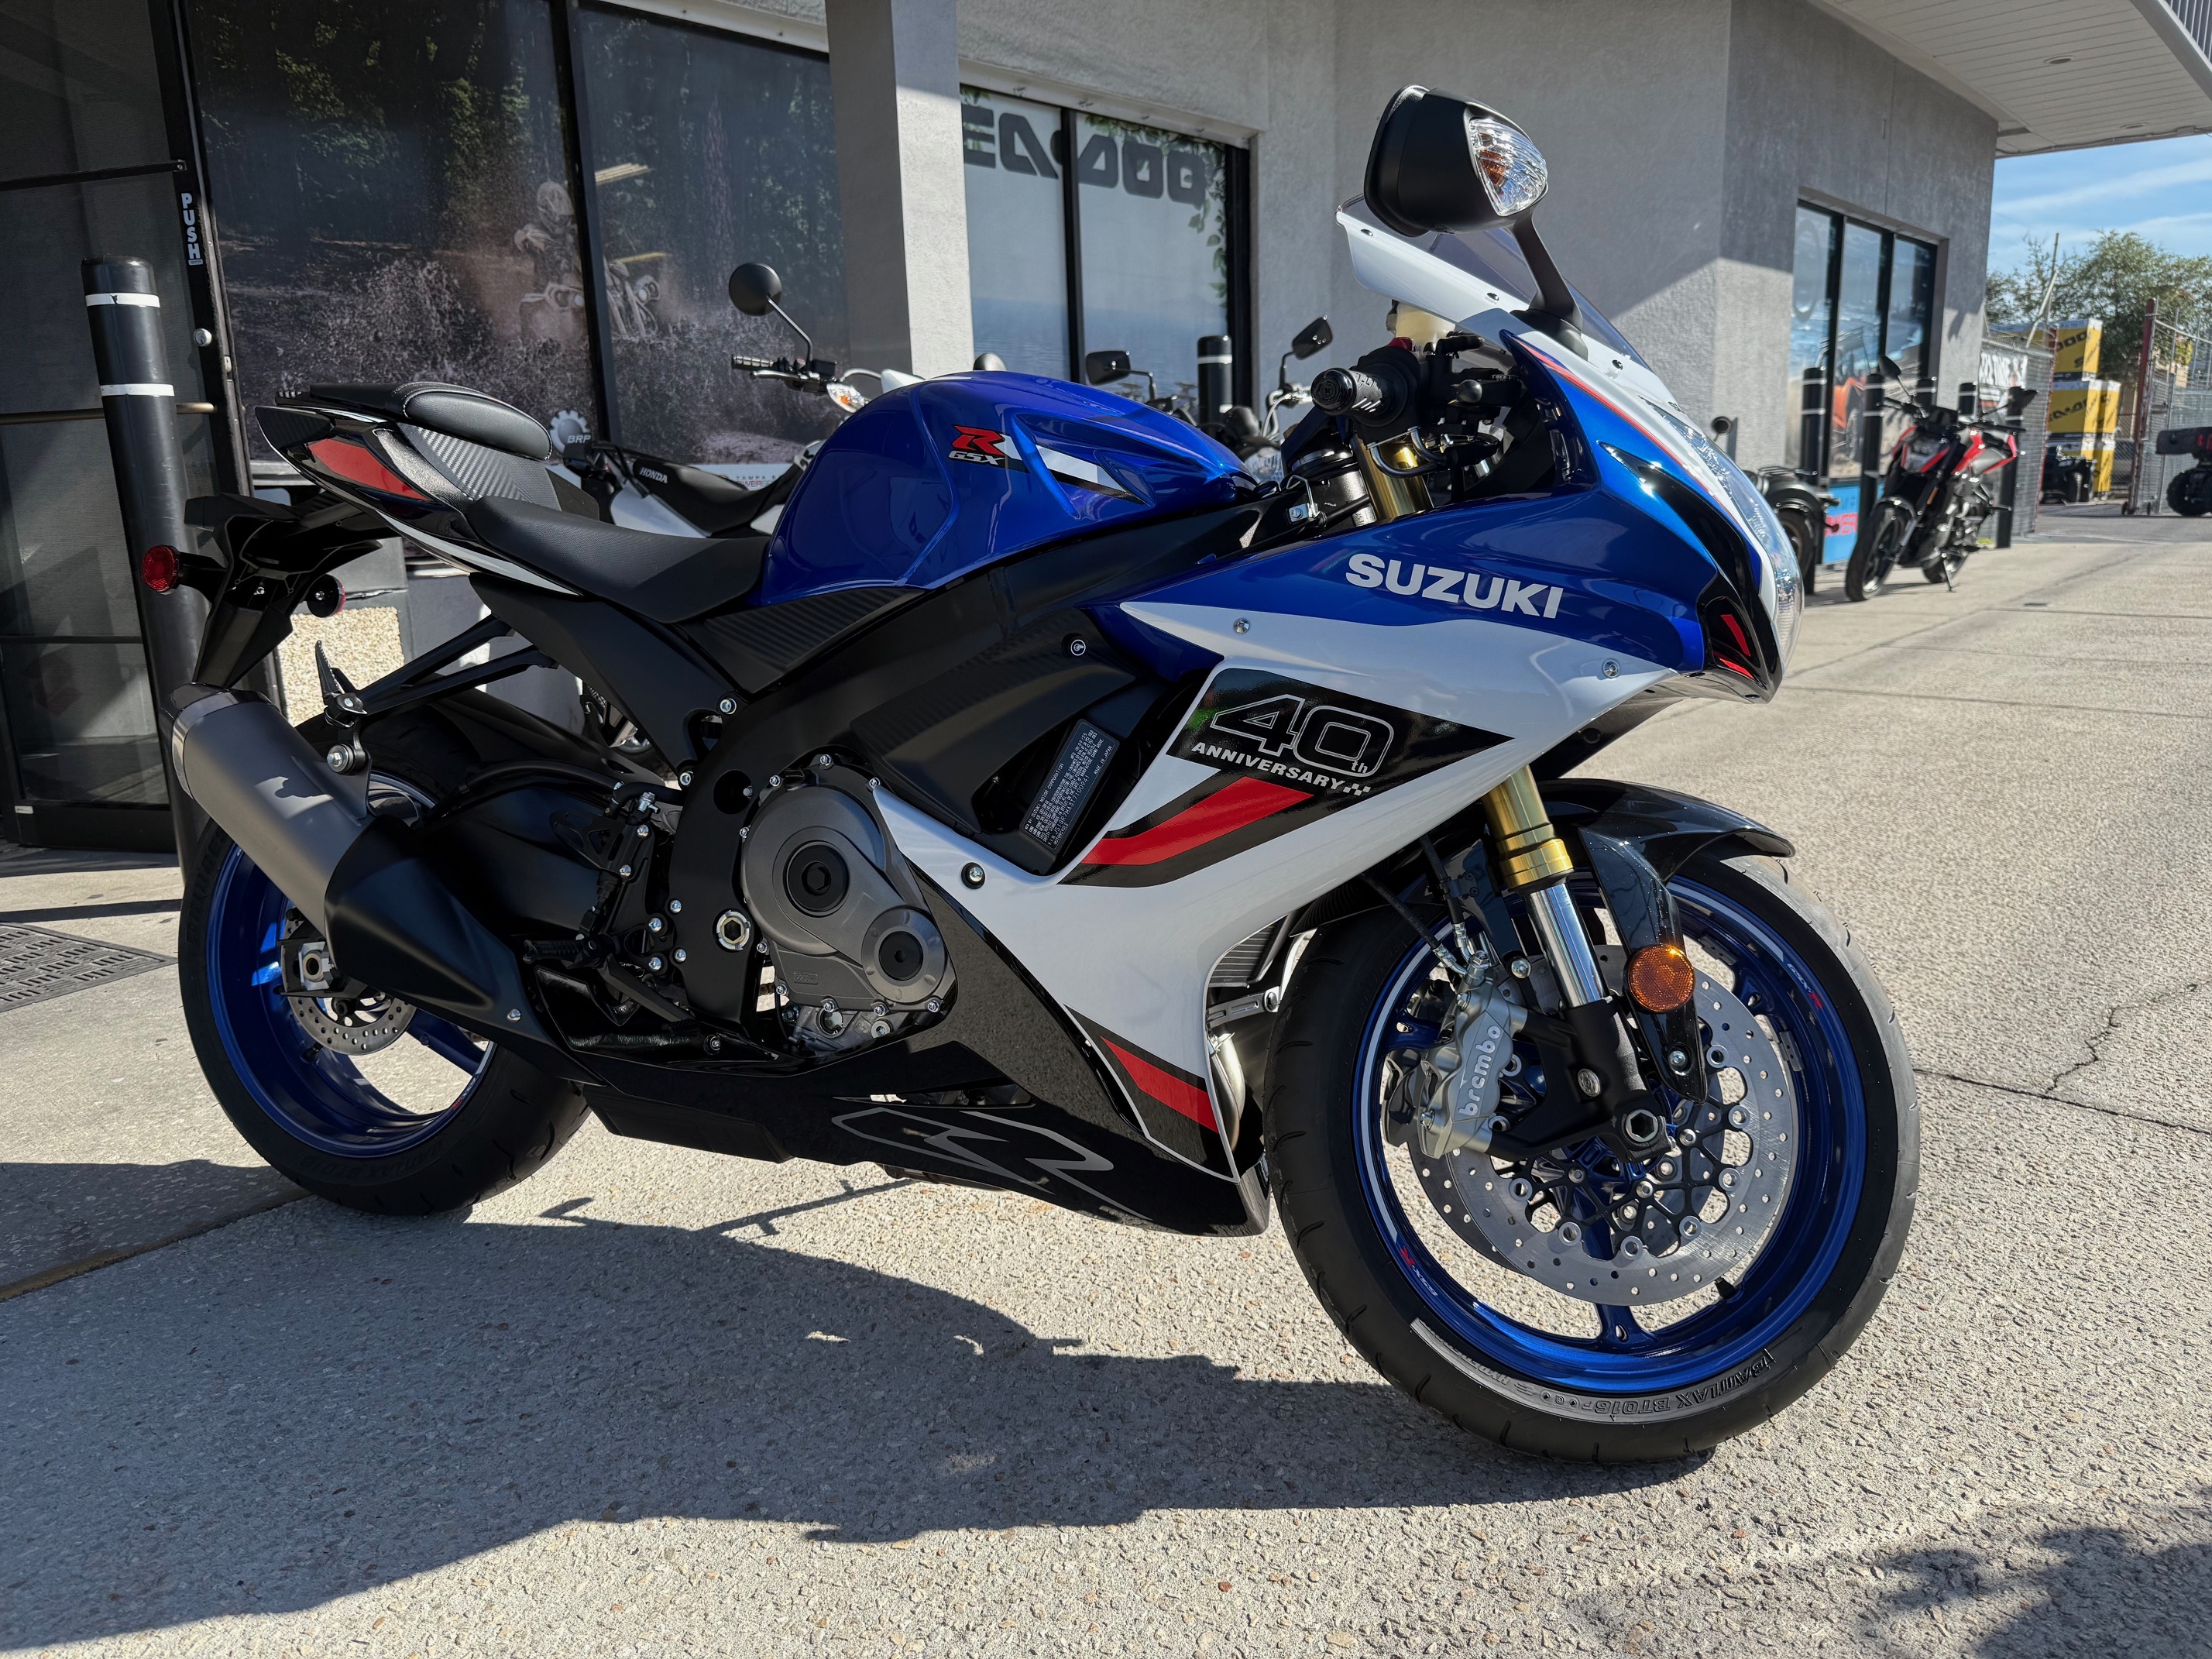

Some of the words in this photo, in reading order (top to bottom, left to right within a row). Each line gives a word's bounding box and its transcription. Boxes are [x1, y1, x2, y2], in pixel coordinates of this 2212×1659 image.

[181, 193, 201, 259] PUSH
[567, 434, 591, 444] BRP
[948, 450, 1005, 465] GSX
[639, 467, 668, 484] HONDA
[1345, 553, 1564, 619] SUZUKI
[1191, 742, 1345, 790] ANNIVERSARY
[1458, 1025, 1501, 1116] brembo
